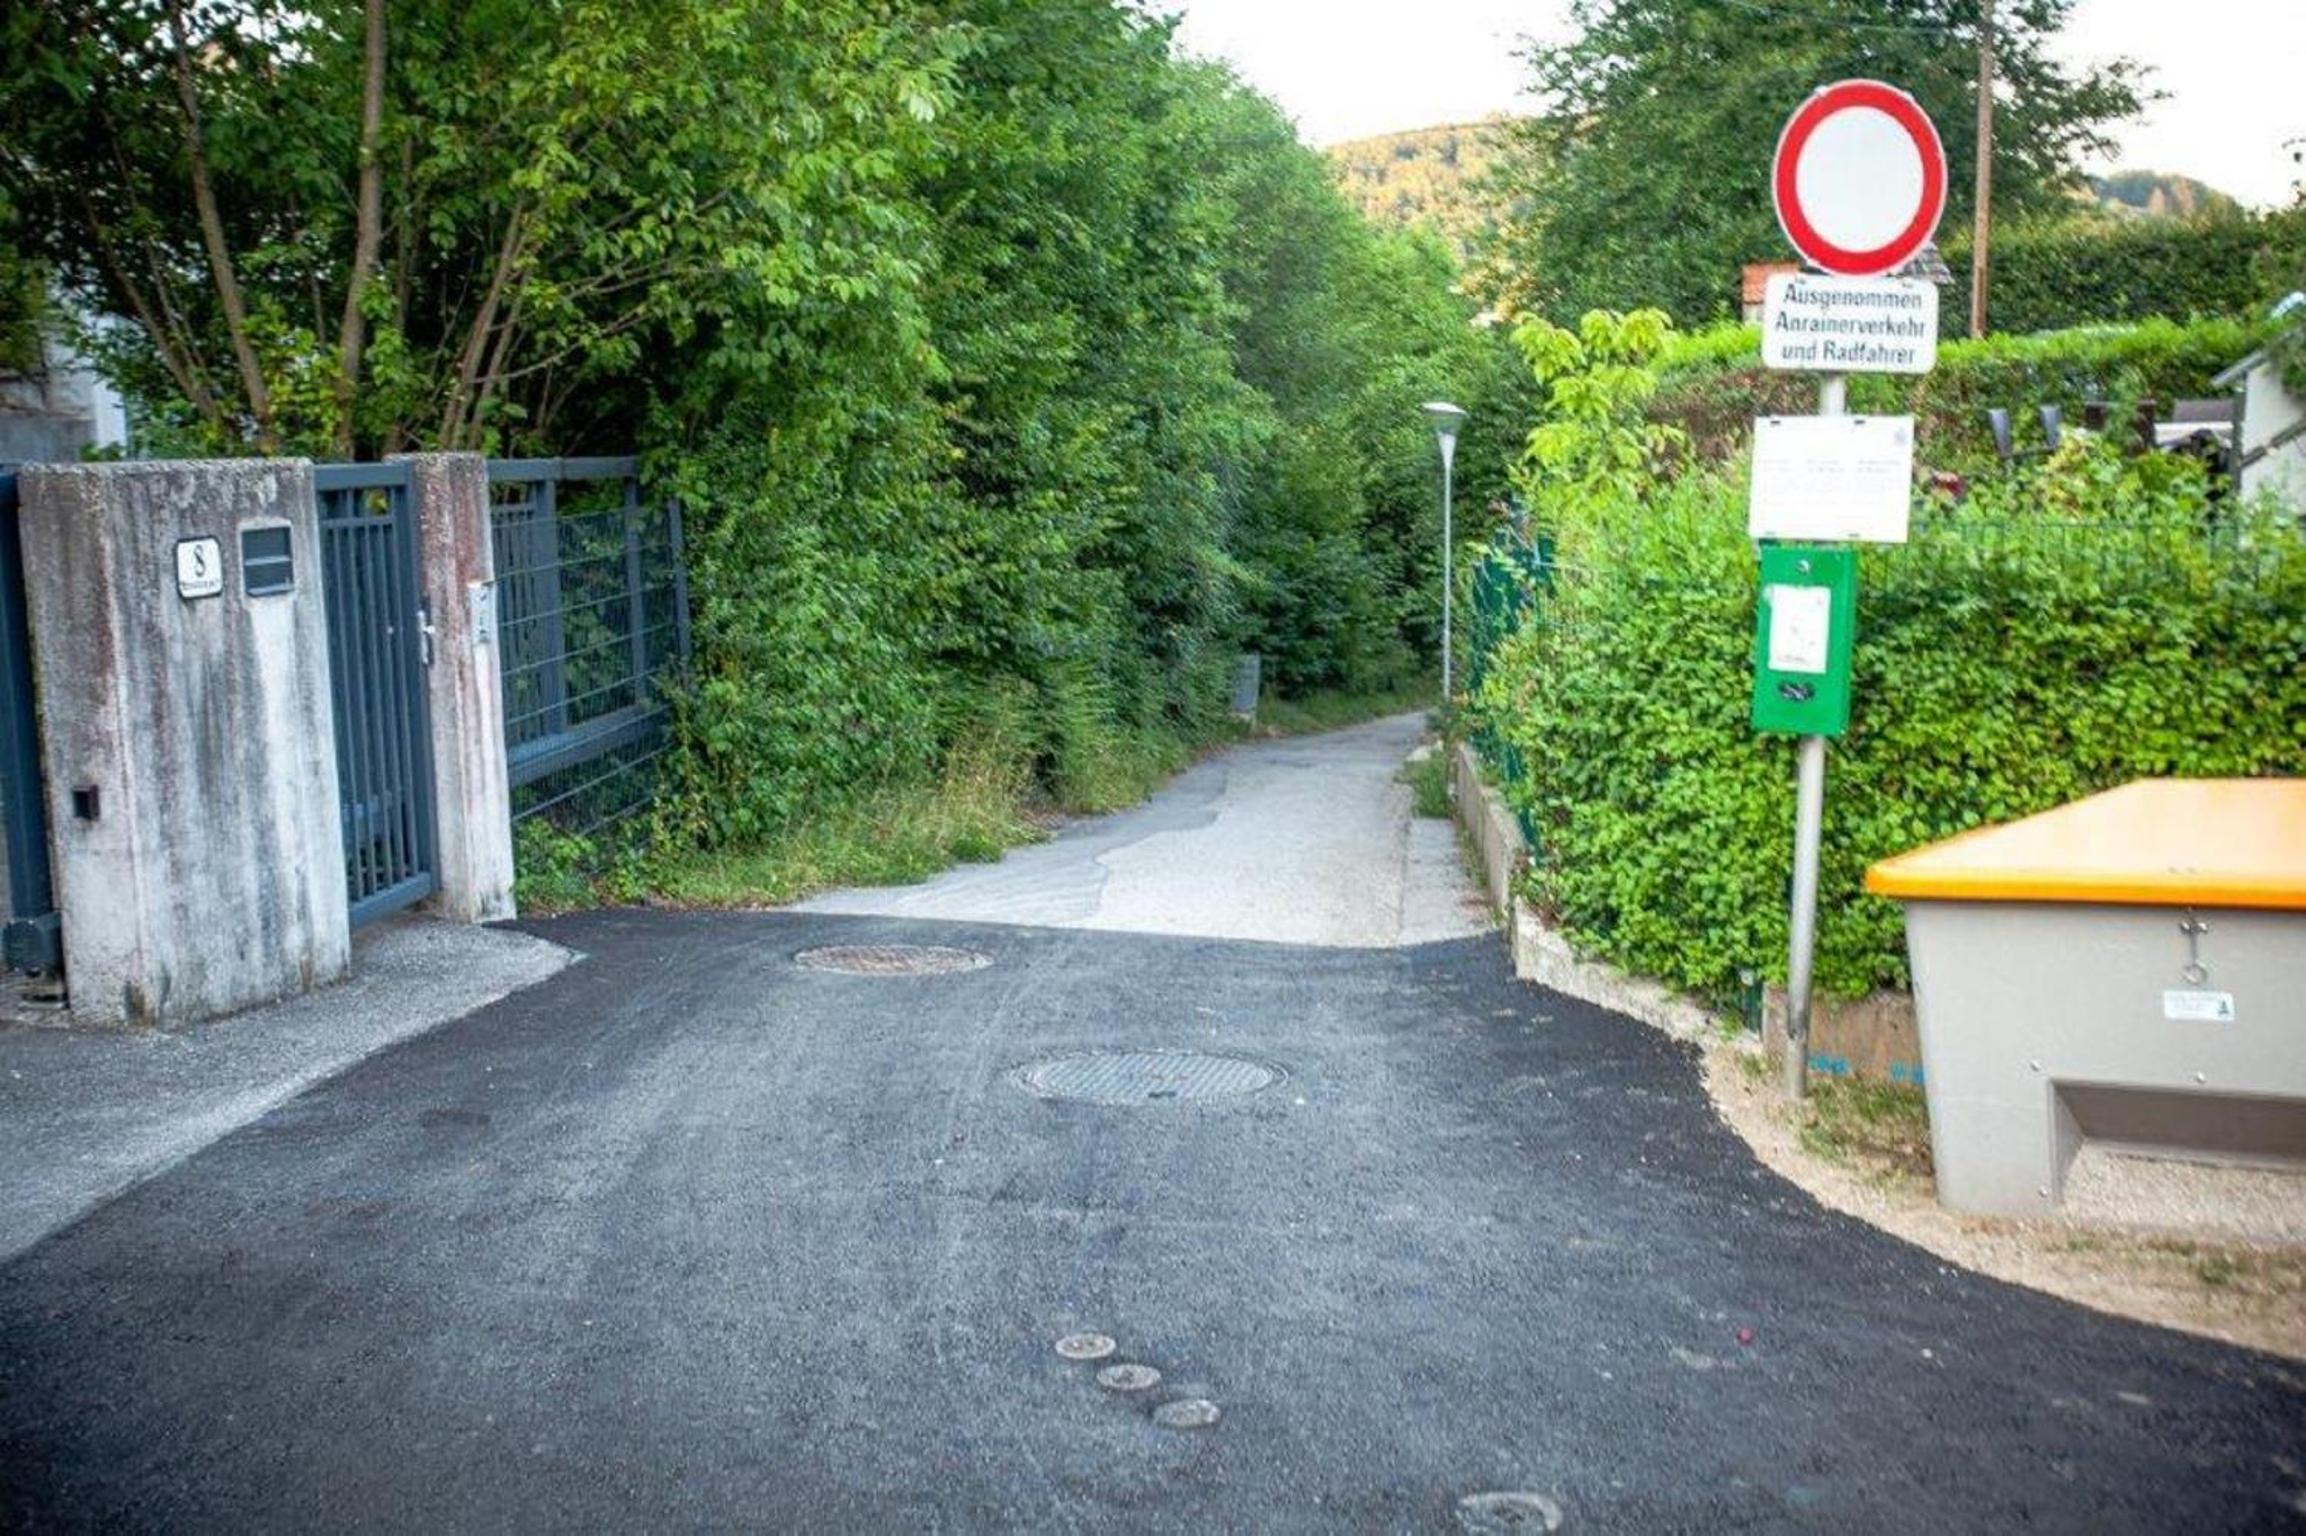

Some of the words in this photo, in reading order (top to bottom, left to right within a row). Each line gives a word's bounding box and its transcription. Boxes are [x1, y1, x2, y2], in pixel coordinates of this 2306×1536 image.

[1785, 283, 1922, 310] Ausgenommen
[1776, 311, 1924, 337] Anrainerverkehr
[1782, 342, 1817, 361] und
[1823, 341, 1915, 364] Radfahrer
